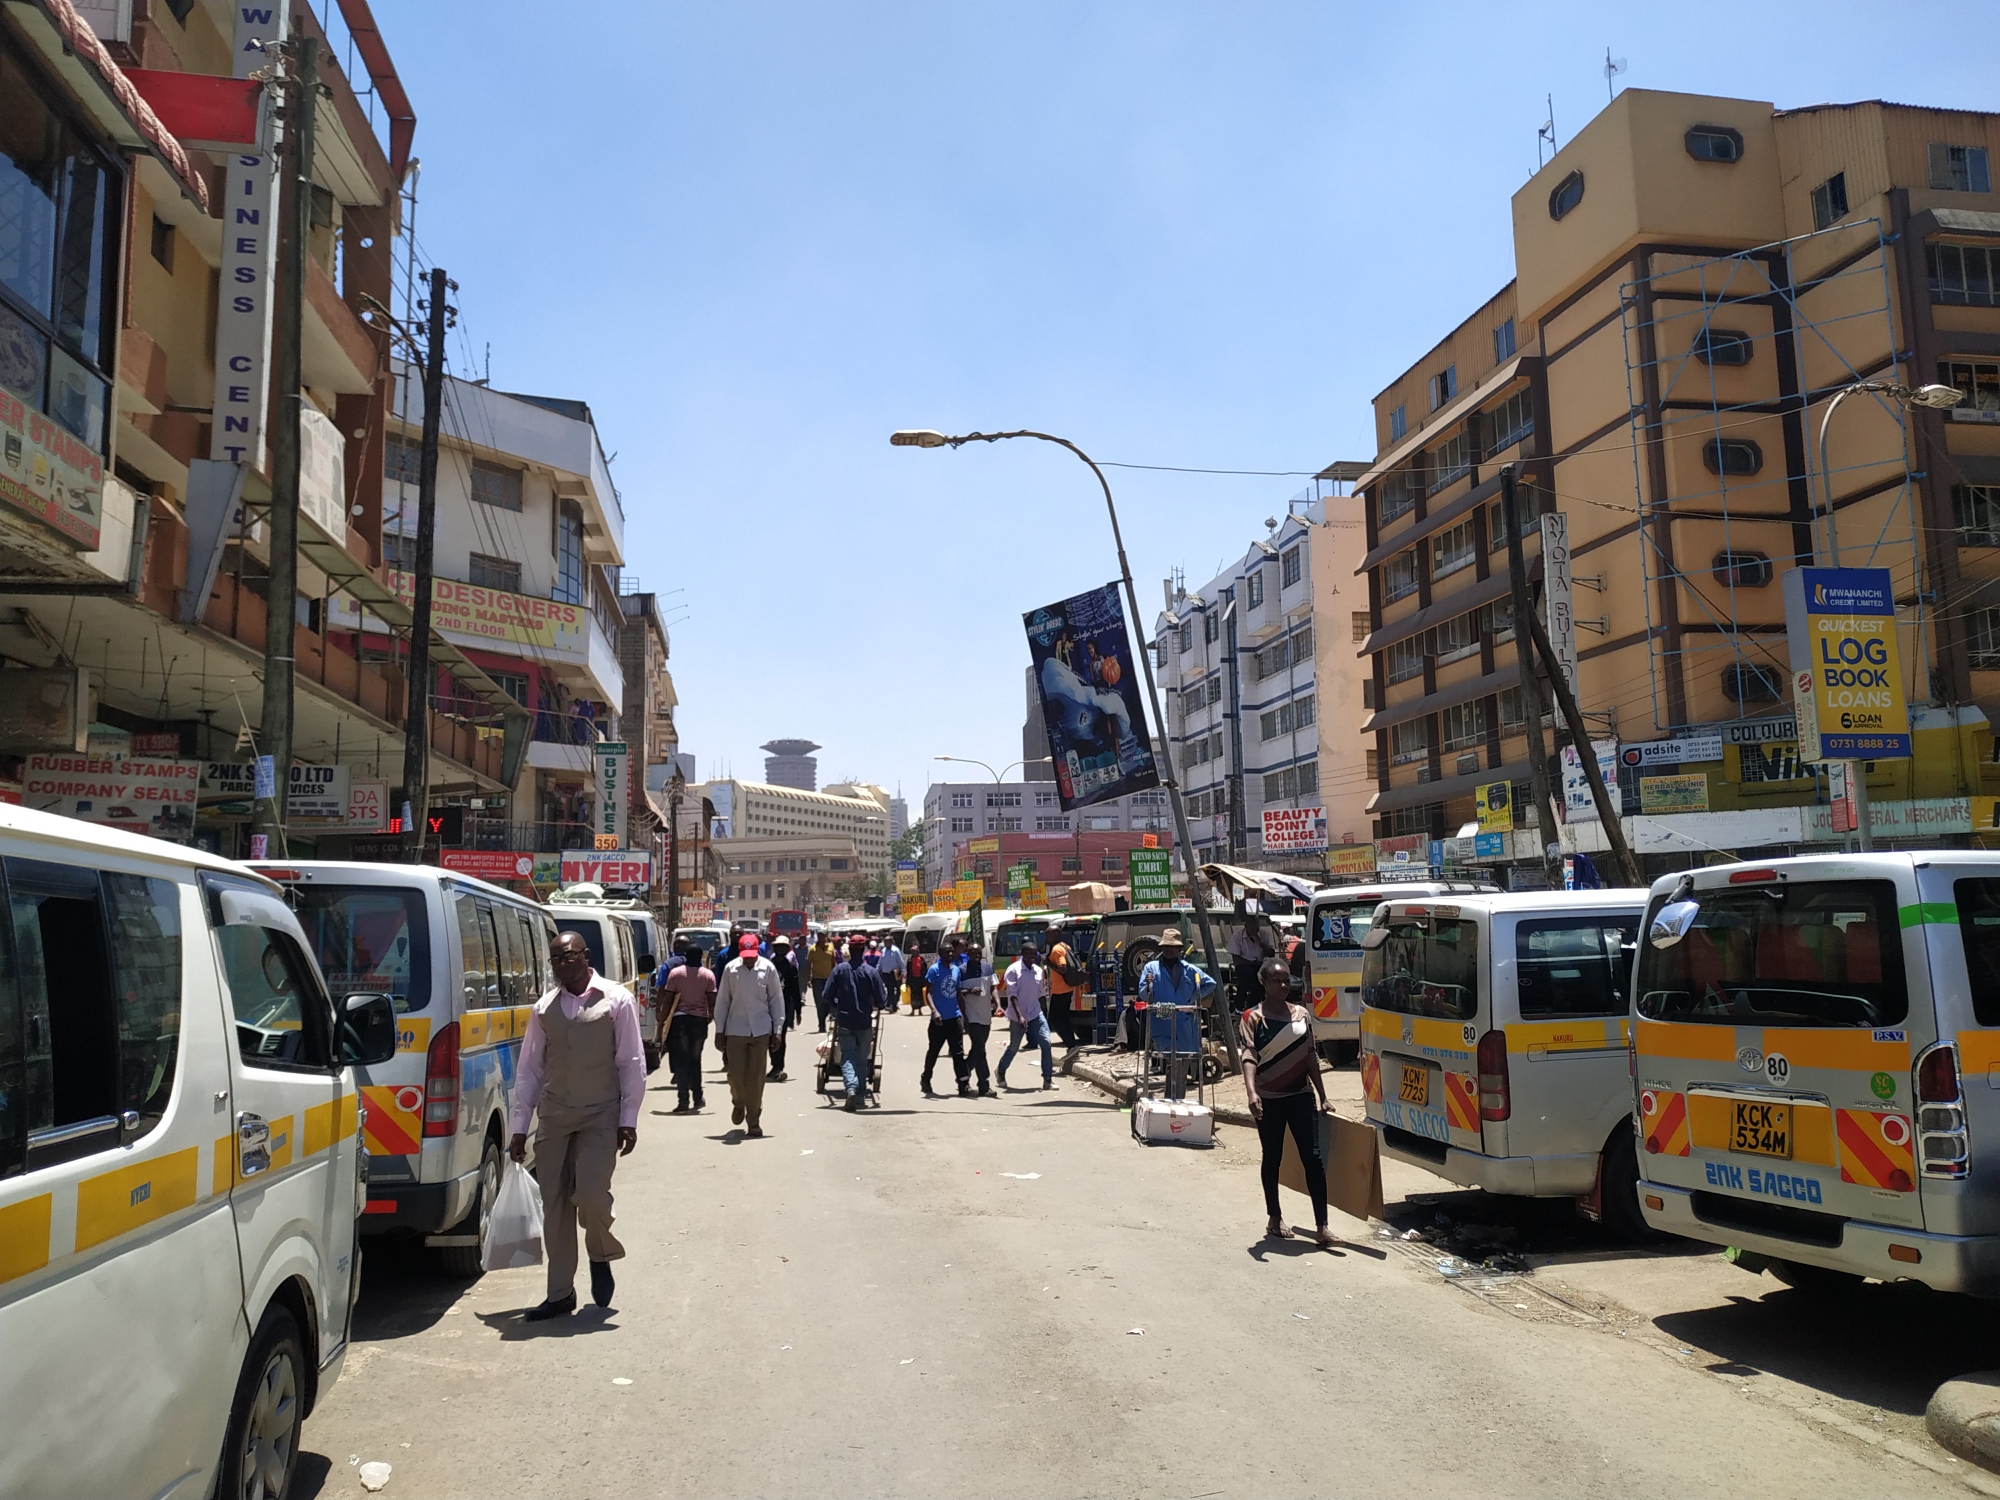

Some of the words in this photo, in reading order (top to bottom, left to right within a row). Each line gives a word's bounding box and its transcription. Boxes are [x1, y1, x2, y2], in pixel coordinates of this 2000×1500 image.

[241, 8, 272, 52] WA
[233, 155, 261, 313] SINESS
[224, 356, 252, 463] CENT
[0, 392, 25, 435] ER
[29, 412, 102, 484] STAMPS
[27, 493, 47, 514] SIGNS
[1549, 515, 1568, 592] NYOTA
[436, 581, 577, 623] DESIGNERS
[1829, 588, 1882, 598] MWANANCHI
[436, 616, 461, 629] 2ND
[466, 621, 506, 637] FLOOR
[475, 609, 544, 630] MASTERS
[1818, 620, 1884, 633] QUICKEST
[1554, 602, 1575, 695] BUILDI
[1821, 638, 1887, 665] LOG
[1824, 669, 1890, 687] BOOK
[1828, 691, 1892, 708] LOANS
[1841, 712, 1852, 729] 6
[1852, 714, 1882, 723] LOAN
[1731, 722, 1798, 742] COLOUR
[1644, 743, 1682, 756] adsite
[1830, 739, 1855, 749] 0731
[1858, 739, 1883, 749] 8888
[1887, 738, 1899, 748] 25
[31, 757, 113, 774] RUBBER
[120, 763, 199, 780] STAMPS
[208, 763, 242, 780] 2NK
[305, 767, 334, 782] LTD
[28, 781, 127, 798] COMPANY
[133, 787, 197, 803] SEALS
[220, 781, 254, 793] PARC
[290, 784, 325, 795] VICES
[354, 790, 378, 804] DA
[604, 757, 617, 834] BUSINES
[1264, 808, 1322, 821] BEAUTY
[1905, 804, 1971, 823] MERCHANTS
[1265, 821, 1307, 832] POINT
[1265, 830, 1314, 842] COLLEGE
[596, 839, 618, 850] 350
[1294, 840, 1325, 848] BEAUTY
[1338, 853, 1352, 862] FIRST
[1352, 851, 1366, 860] SIGHT
[562, 861, 649, 882] NYERI
[1138, 862, 1163, 873] EMBU
[1331, 861, 1374, 874] OPTICIANS
[683, 902, 712, 911] NYERI
[902, 895, 927, 904] NAKURU
[902, 904, 927, 914] DIRECT
[1463, 1026, 1476, 1041] 80
[1552, 1034, 1573, 1042] NAKURU
[1422, 1047, 1438, 1057] 0721
[1403, 1065, 1420, 1086] KCN
[1768, 1056, 1788, 1077] 80
[1400, 1082, 1425, 1103] 772S
[1644, 1078, 1673, 1090] HIACE
[1382, 1099, 1406, 1129] 2NK
[1408, 1106, 1450, 1143] SACCO
[1736, 1103, 1773, 1128] KCK
[1735, 1126, 1786, 1154] 534M
[130, 1181, 151, 1207] NYERI
[1747, 1165, 1823, 1206] SACCO
